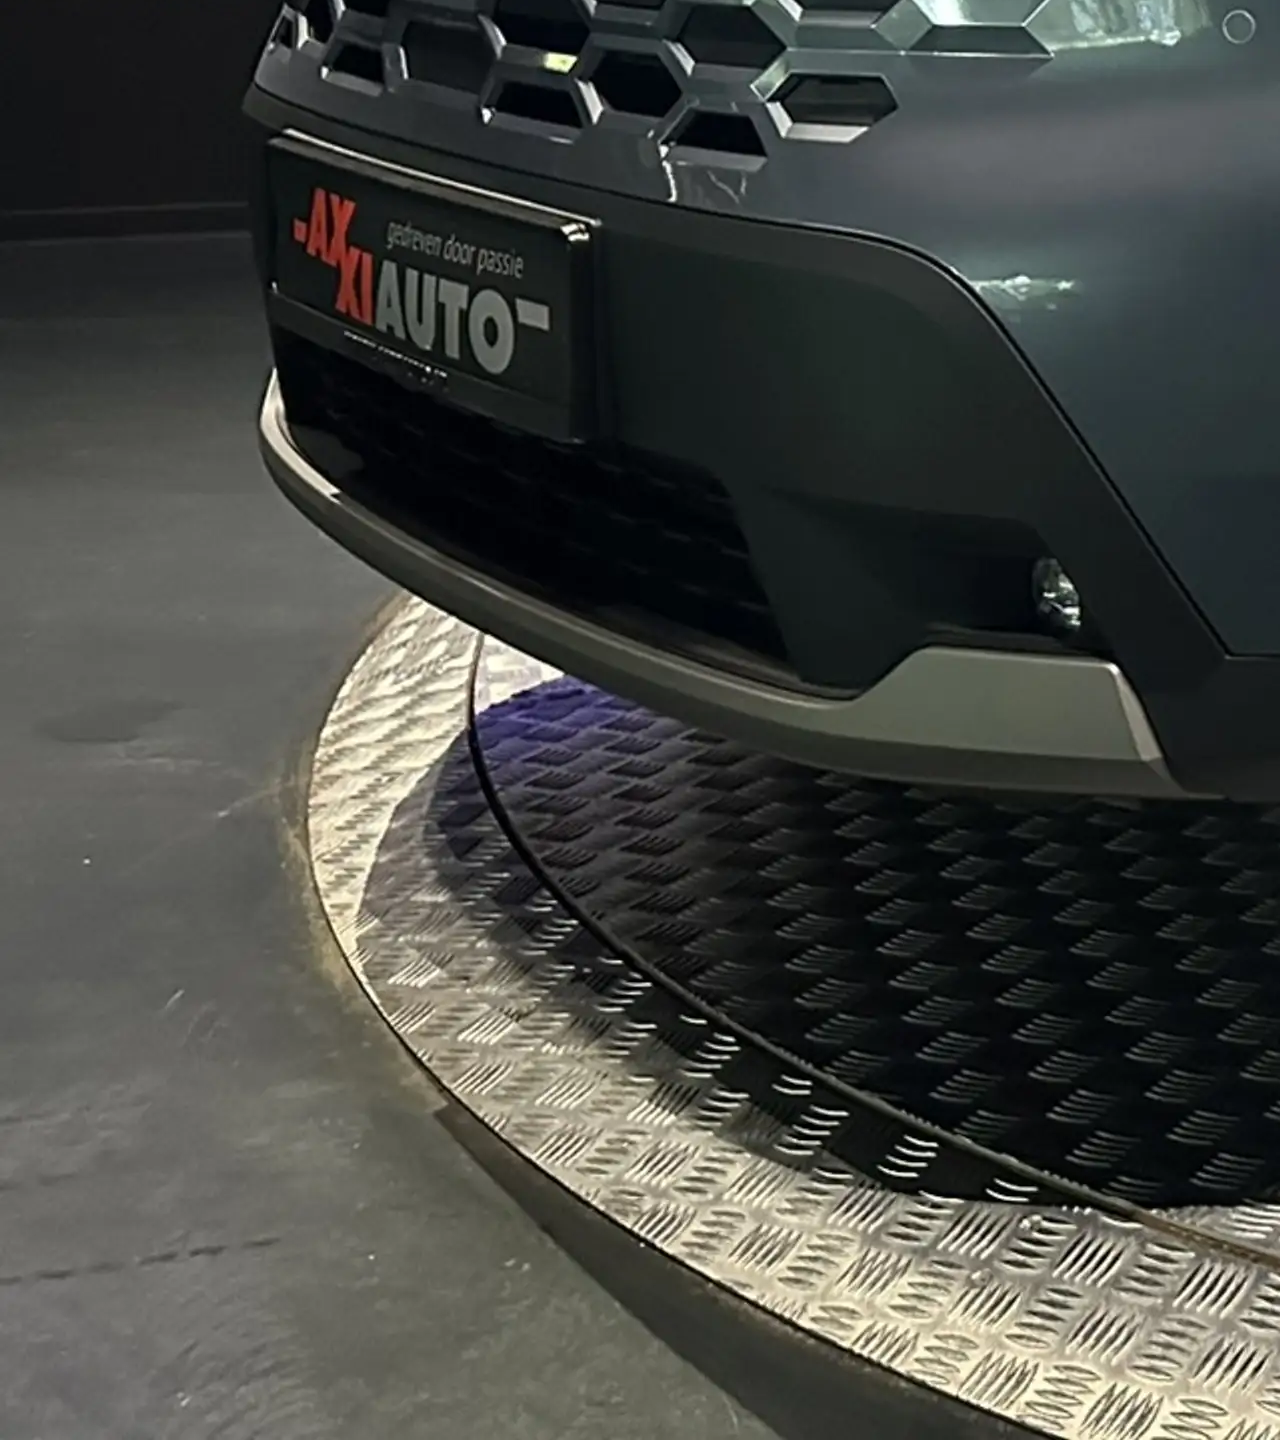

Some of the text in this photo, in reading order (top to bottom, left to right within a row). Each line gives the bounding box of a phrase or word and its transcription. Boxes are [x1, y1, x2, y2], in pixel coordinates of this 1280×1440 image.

[386, 220, 524, 279] gedreven door passie
